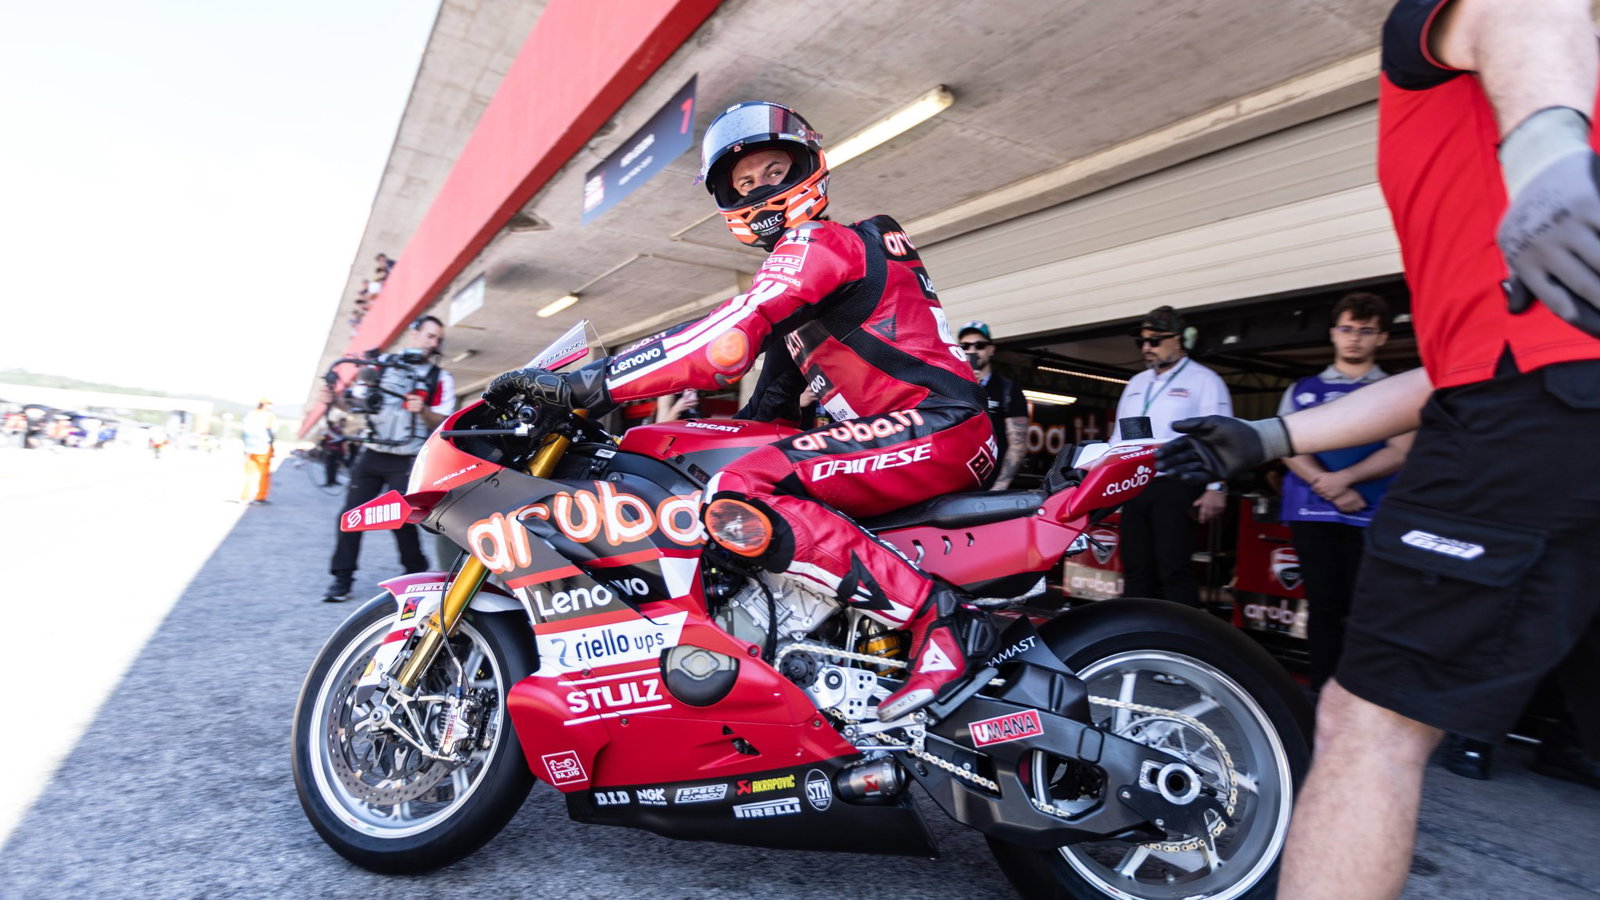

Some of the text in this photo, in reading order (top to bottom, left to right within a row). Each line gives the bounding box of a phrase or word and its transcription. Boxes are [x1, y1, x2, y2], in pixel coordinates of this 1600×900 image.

[680, 97, 693, 134] 1
[610, 347, 662, 375] Lenovo
[685, 421, 740, 433] DUCATI
[811, 442, 932, 482] DAINESE
[466, 479, 708, 575] aruba
[534, 577, 650, 617] Lenovo
[575, 628, 665, 662] riello ups
[566, 678, 663, 714] STULZ
[973, 713, 1037, 743] UMANA
[636, 788, 666, 801] NGK
[806, 781, 831, 800] STM
[732, 796, 802, 818] PIRELLI
